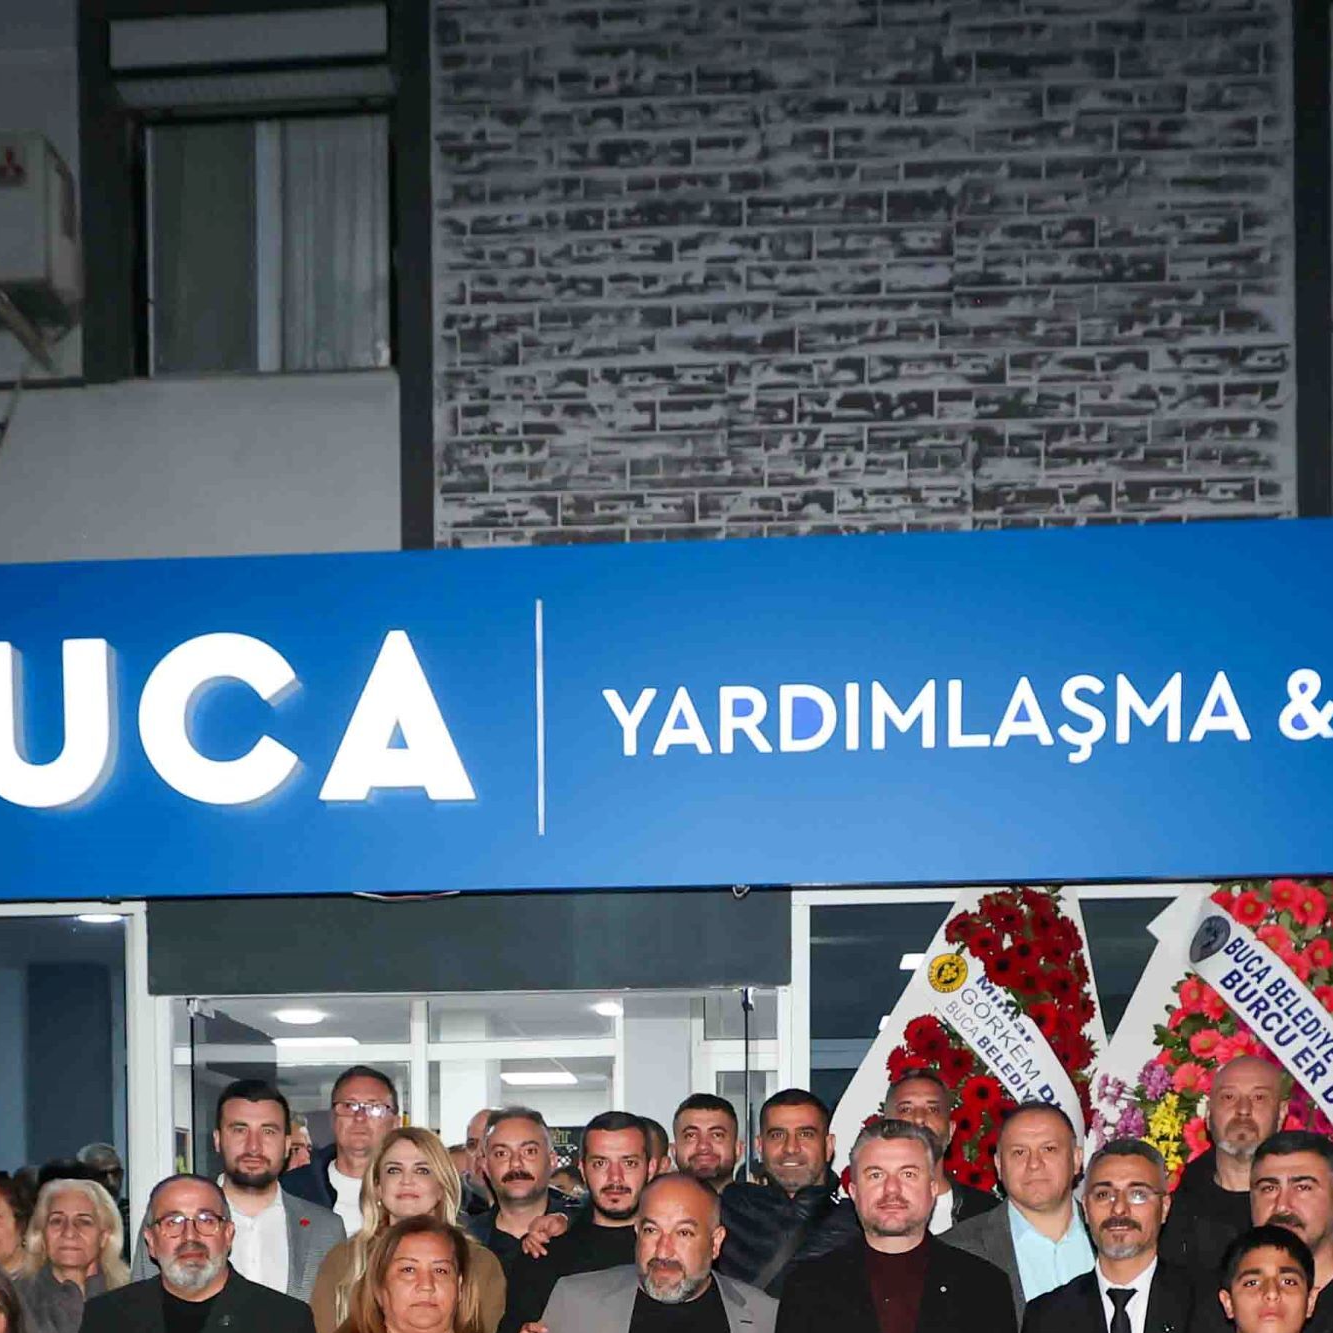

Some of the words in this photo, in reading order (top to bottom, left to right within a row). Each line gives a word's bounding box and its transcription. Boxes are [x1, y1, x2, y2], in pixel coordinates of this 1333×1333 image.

[601, 670, 1252, 765] YARDIMLAŞMA
[1223, 936, 1272, 984] BUCA
[945, 1000, 980, 1040] BUCA
[960, 988, 1042, 1081] GÖRKEM
[1219, 968, 1300, 1048] BURCU
[1290, 1045, 1328, 1087] ER
